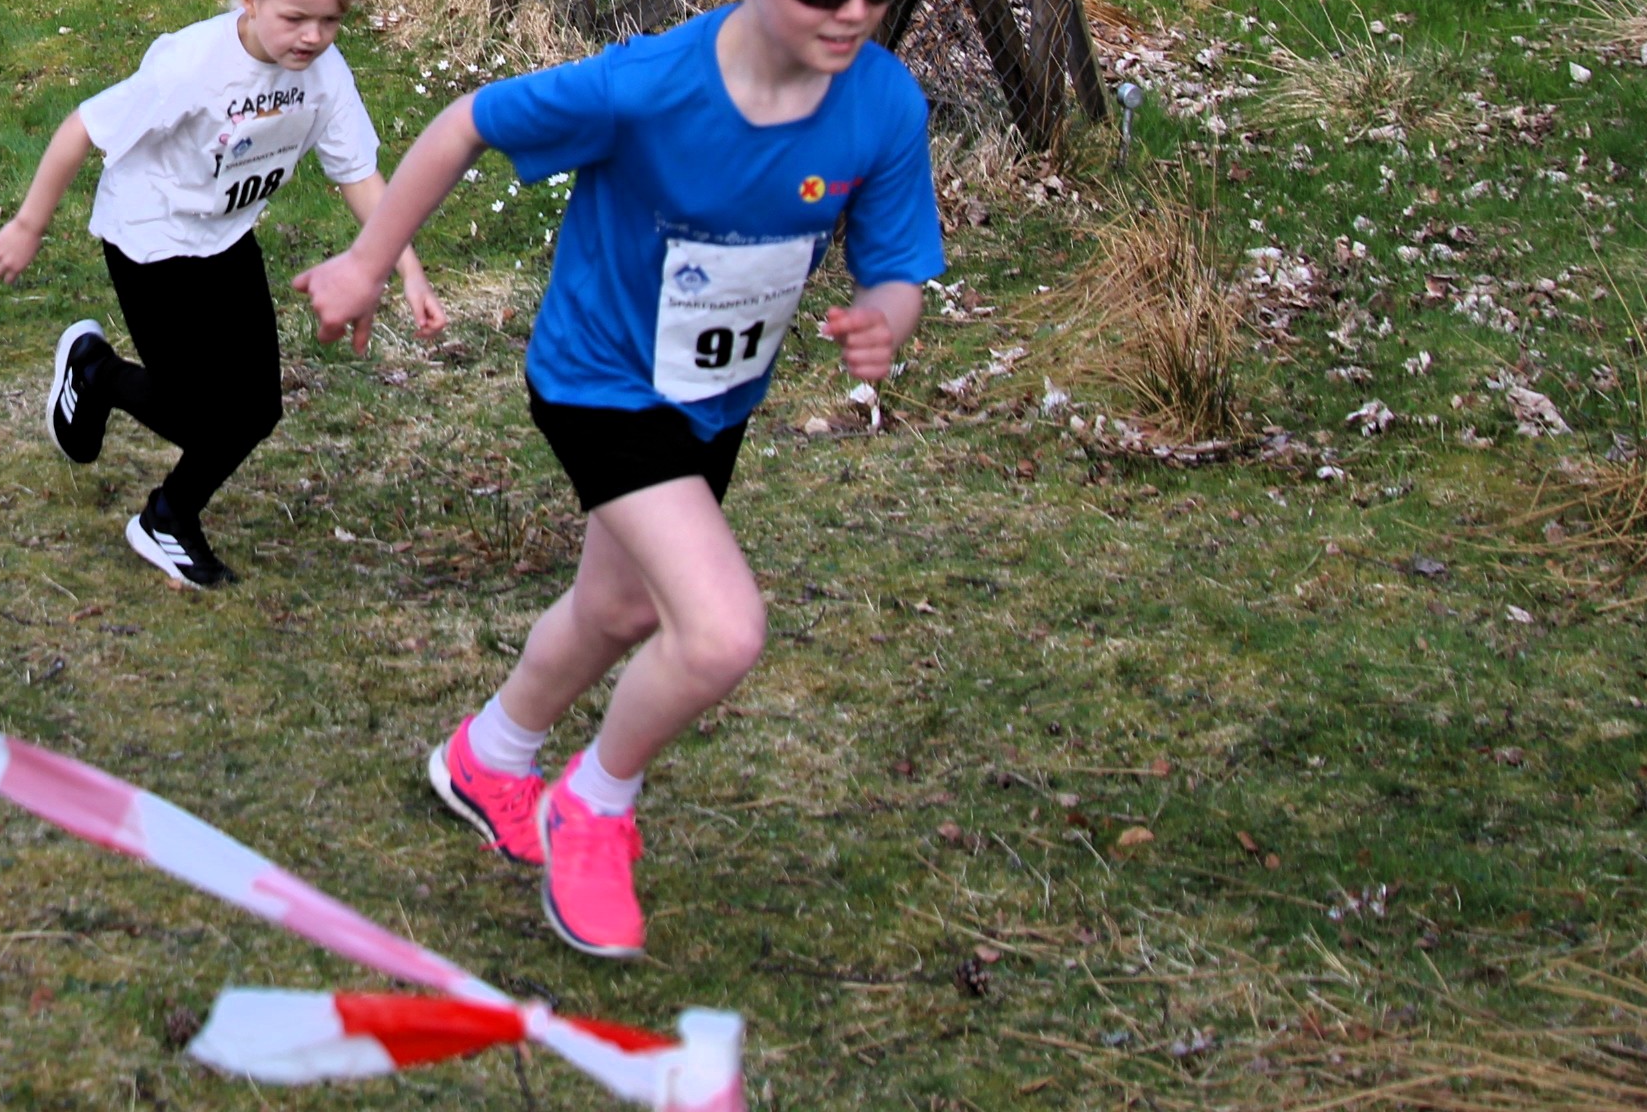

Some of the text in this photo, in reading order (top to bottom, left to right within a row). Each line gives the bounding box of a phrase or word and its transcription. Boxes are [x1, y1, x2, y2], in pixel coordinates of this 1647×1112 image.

[227, 87, 305, 118] CAPYBARA
[224, 167, 285, 215] 108
[694, 320, 765, 369] 91
